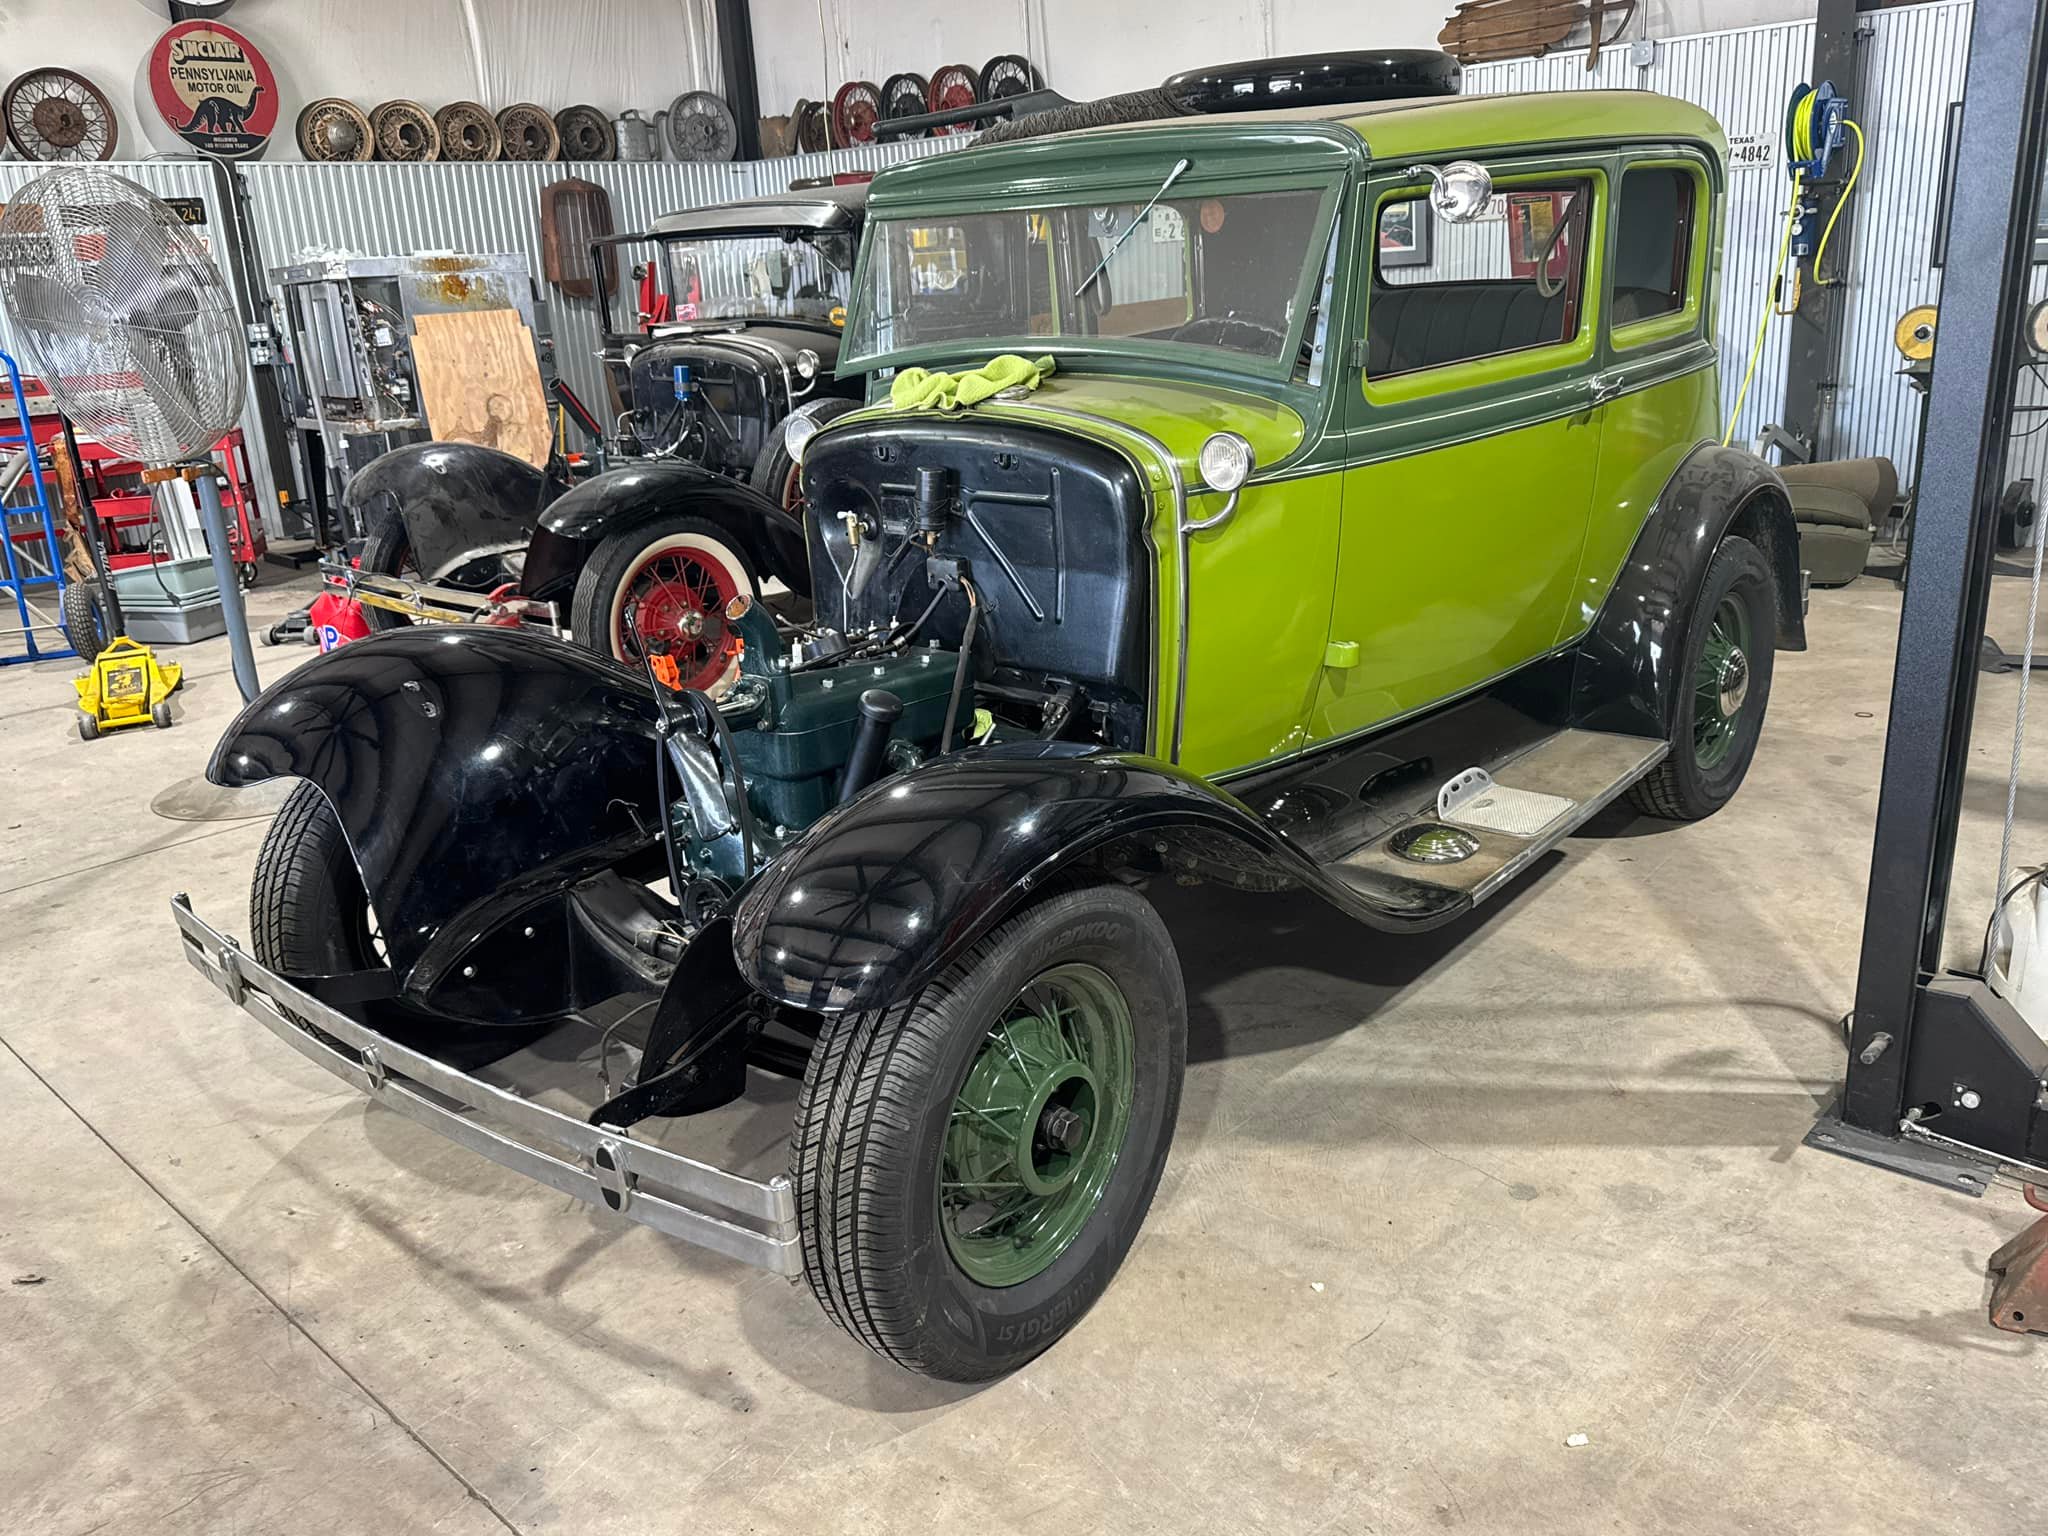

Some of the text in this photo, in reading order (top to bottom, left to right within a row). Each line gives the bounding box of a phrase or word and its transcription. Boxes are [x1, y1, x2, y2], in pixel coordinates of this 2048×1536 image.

[170, 38, 244, 64] SINCLAIR
[170, 66, 254, 82] PENNSYLVANIA
[188, 82, 243, 94] MOTOR OIL
[1729, 136, 1755, 145] TEXAS
